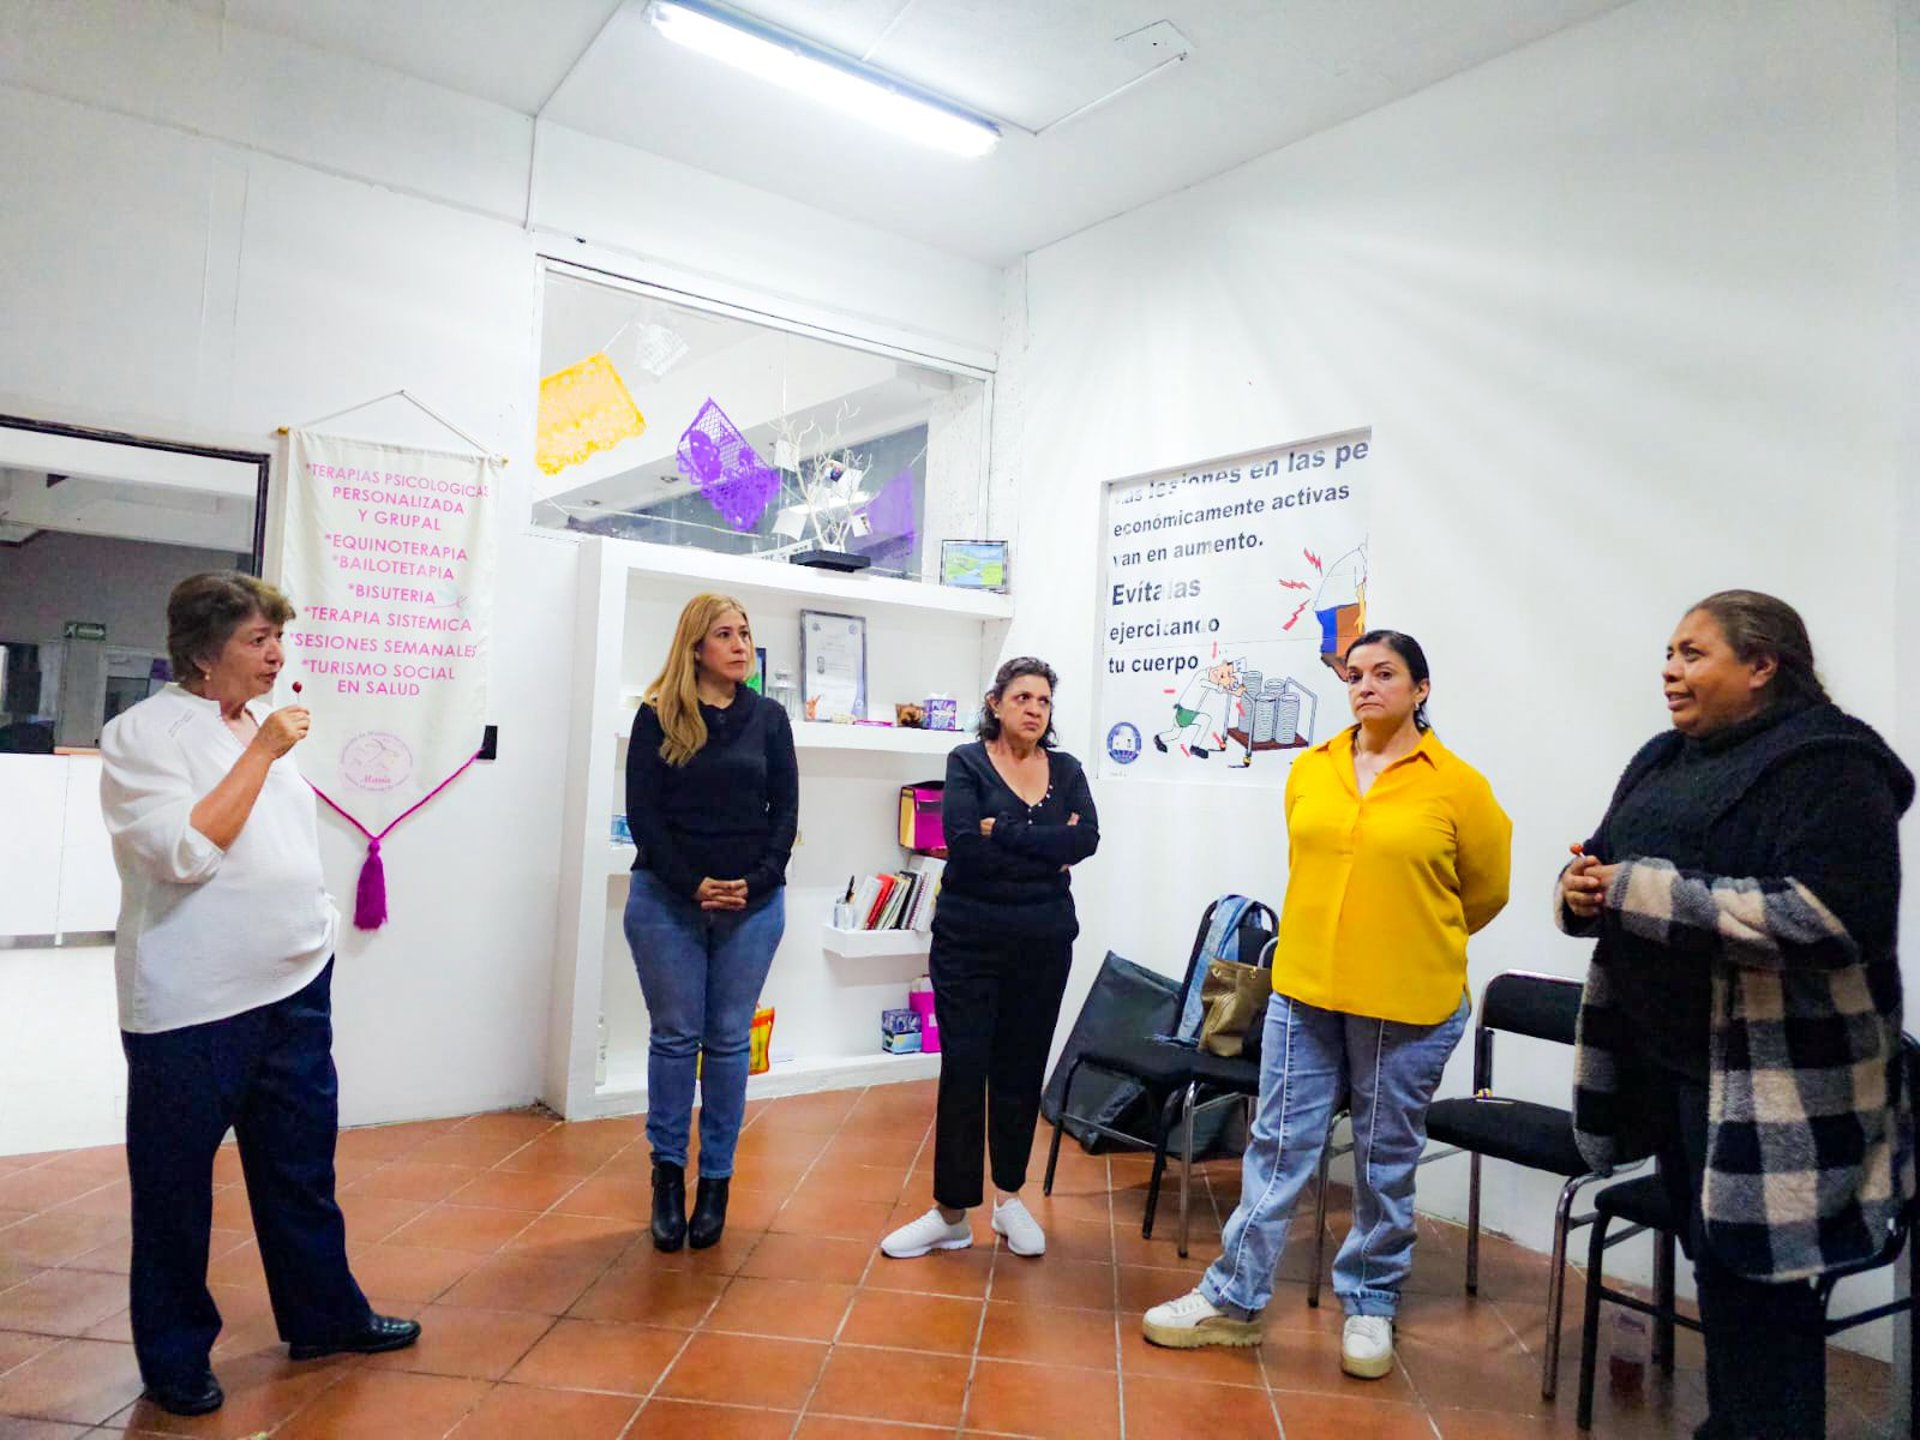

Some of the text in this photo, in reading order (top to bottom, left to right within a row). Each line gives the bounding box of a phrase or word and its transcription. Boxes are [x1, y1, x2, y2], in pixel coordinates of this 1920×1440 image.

[1116, 488, 1143, 505] as
[1250, 458, 1279, 480] en
[1287, 451, 1326, 473] las
[1335, 441, 1369, 470] pe
[332, 485, 465, 516] PERSONALIZADA
[1114, 484, 1350, 538] económicamente activas
[358, 508, 442, 532] Y GRUPAL
[1147, 547, 1168, 563] en
[1173, 531, 1264, 559] aumento.
[386, 612, 472, 633] SISTEMICA
[1109, 617, 1221, 645] ejerciano
[393, 663, 456, 682] SOCIAL
[1108, 655, 1200, 676] tu cuerpo
[337, 678, 421, 697] EN SALUD
